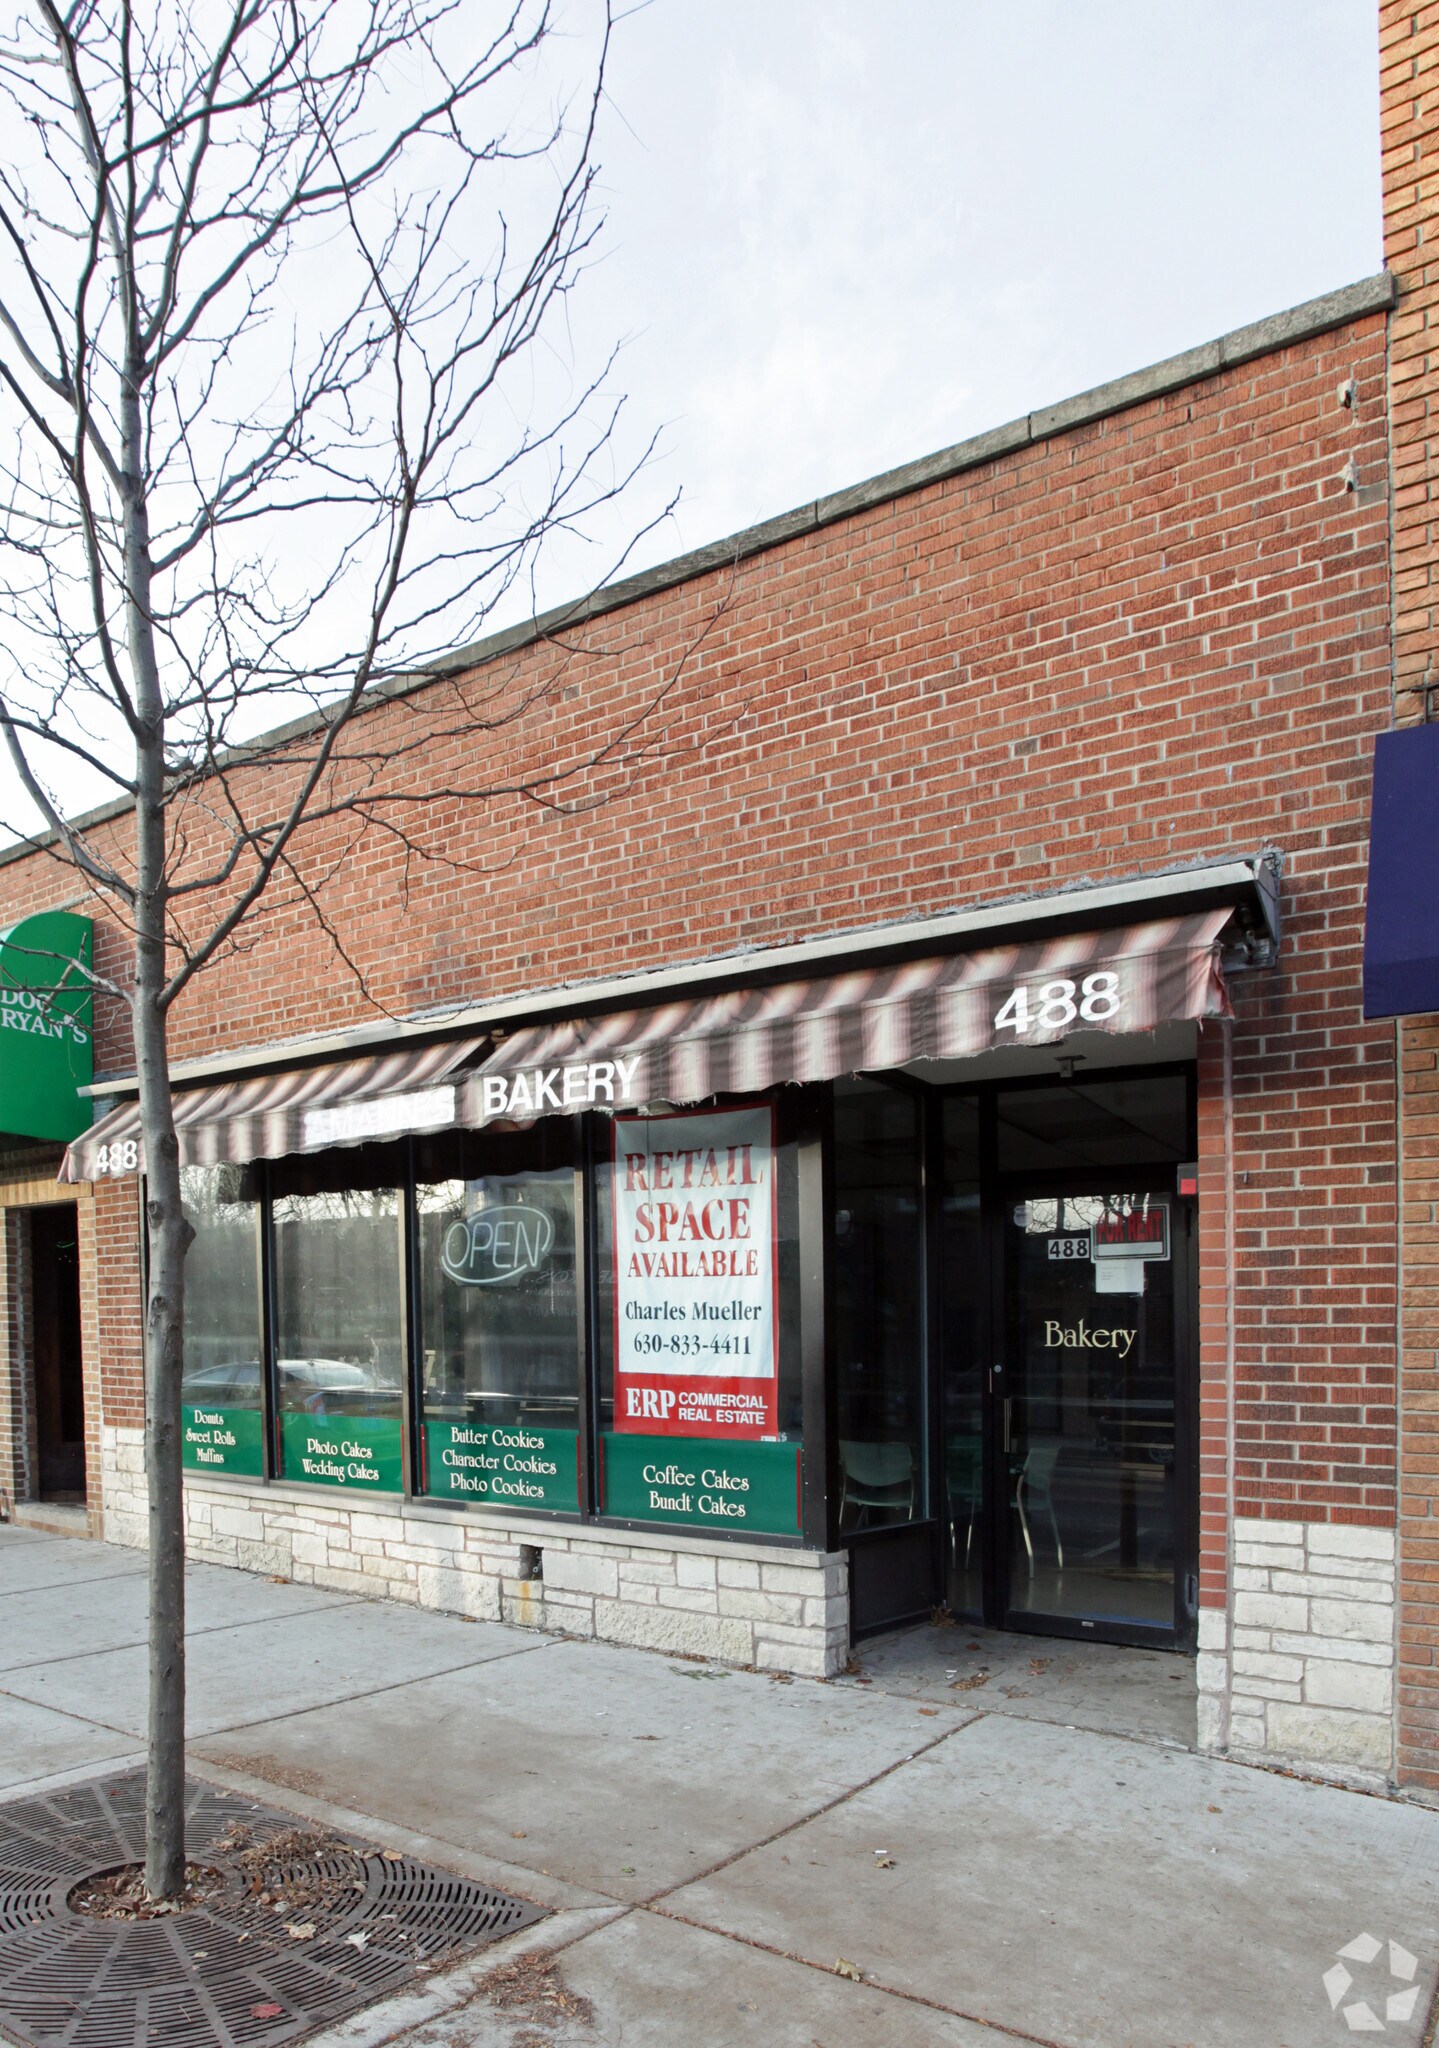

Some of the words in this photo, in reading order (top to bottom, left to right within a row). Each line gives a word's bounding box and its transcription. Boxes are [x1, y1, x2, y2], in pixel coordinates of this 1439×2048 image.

[0, 990, 52, 1012] DOC
[994, 971, 1121, 1034] 488
[482, 1055, 642, 1116] BAKERY
[96, 1140, 138, 1173] 488
[624, 1143, 763, 1191] RETAIL
[634, 1198, 751, 1243] SPACE
[445, 1221, 541, 1269] OPEN
[1049, 1239, 1089, 1258] 488
[628, 1249, 759, 1278] AVAILABLE
[625, 1300, 687, 1321] Charles
[692, 1300, 762, 1321] Mueller
[634, 1331, 751, 1356] 630-833-4411
[1044, 1319, 1137, 1358] Bakery
[626, 1387, 676, 1419] ERP
[678, 1391, 768, 1409] COMMERCIAL
[194, 1409, 225, 1426] Donuts
[678, 1407, 712, 1422] REAL
[716, 1409, 766, 1425] ESTATE
[185, 1427, 212, 1443] Sweet
[213, 1430, 236, 1446] Rolls
[307, 1438, 339, 1456] Photo
[341, 1441, 373, 1459] Cakes
[450, 1426, 489, 1445] Butter
[491, 1429, 545, 1449] Cookies
[196, 1447, 225, 1464] Muffins
[442, 1449, 500, 1470] Character
[503, 1454, 557, 1475] Cookies
[302, 1458, 345, 1483] Wedding
[348, 1463, 380, 1481] Cakes
[643, 1464, 696, 1487] Coffee
[701, 1469, 750, 1492] Cakes
[450, 1472, 488, 1493] Photo
[491, 1476, 545, 1498] Cookies
[698, 1494, 746, 1518] Cakes
